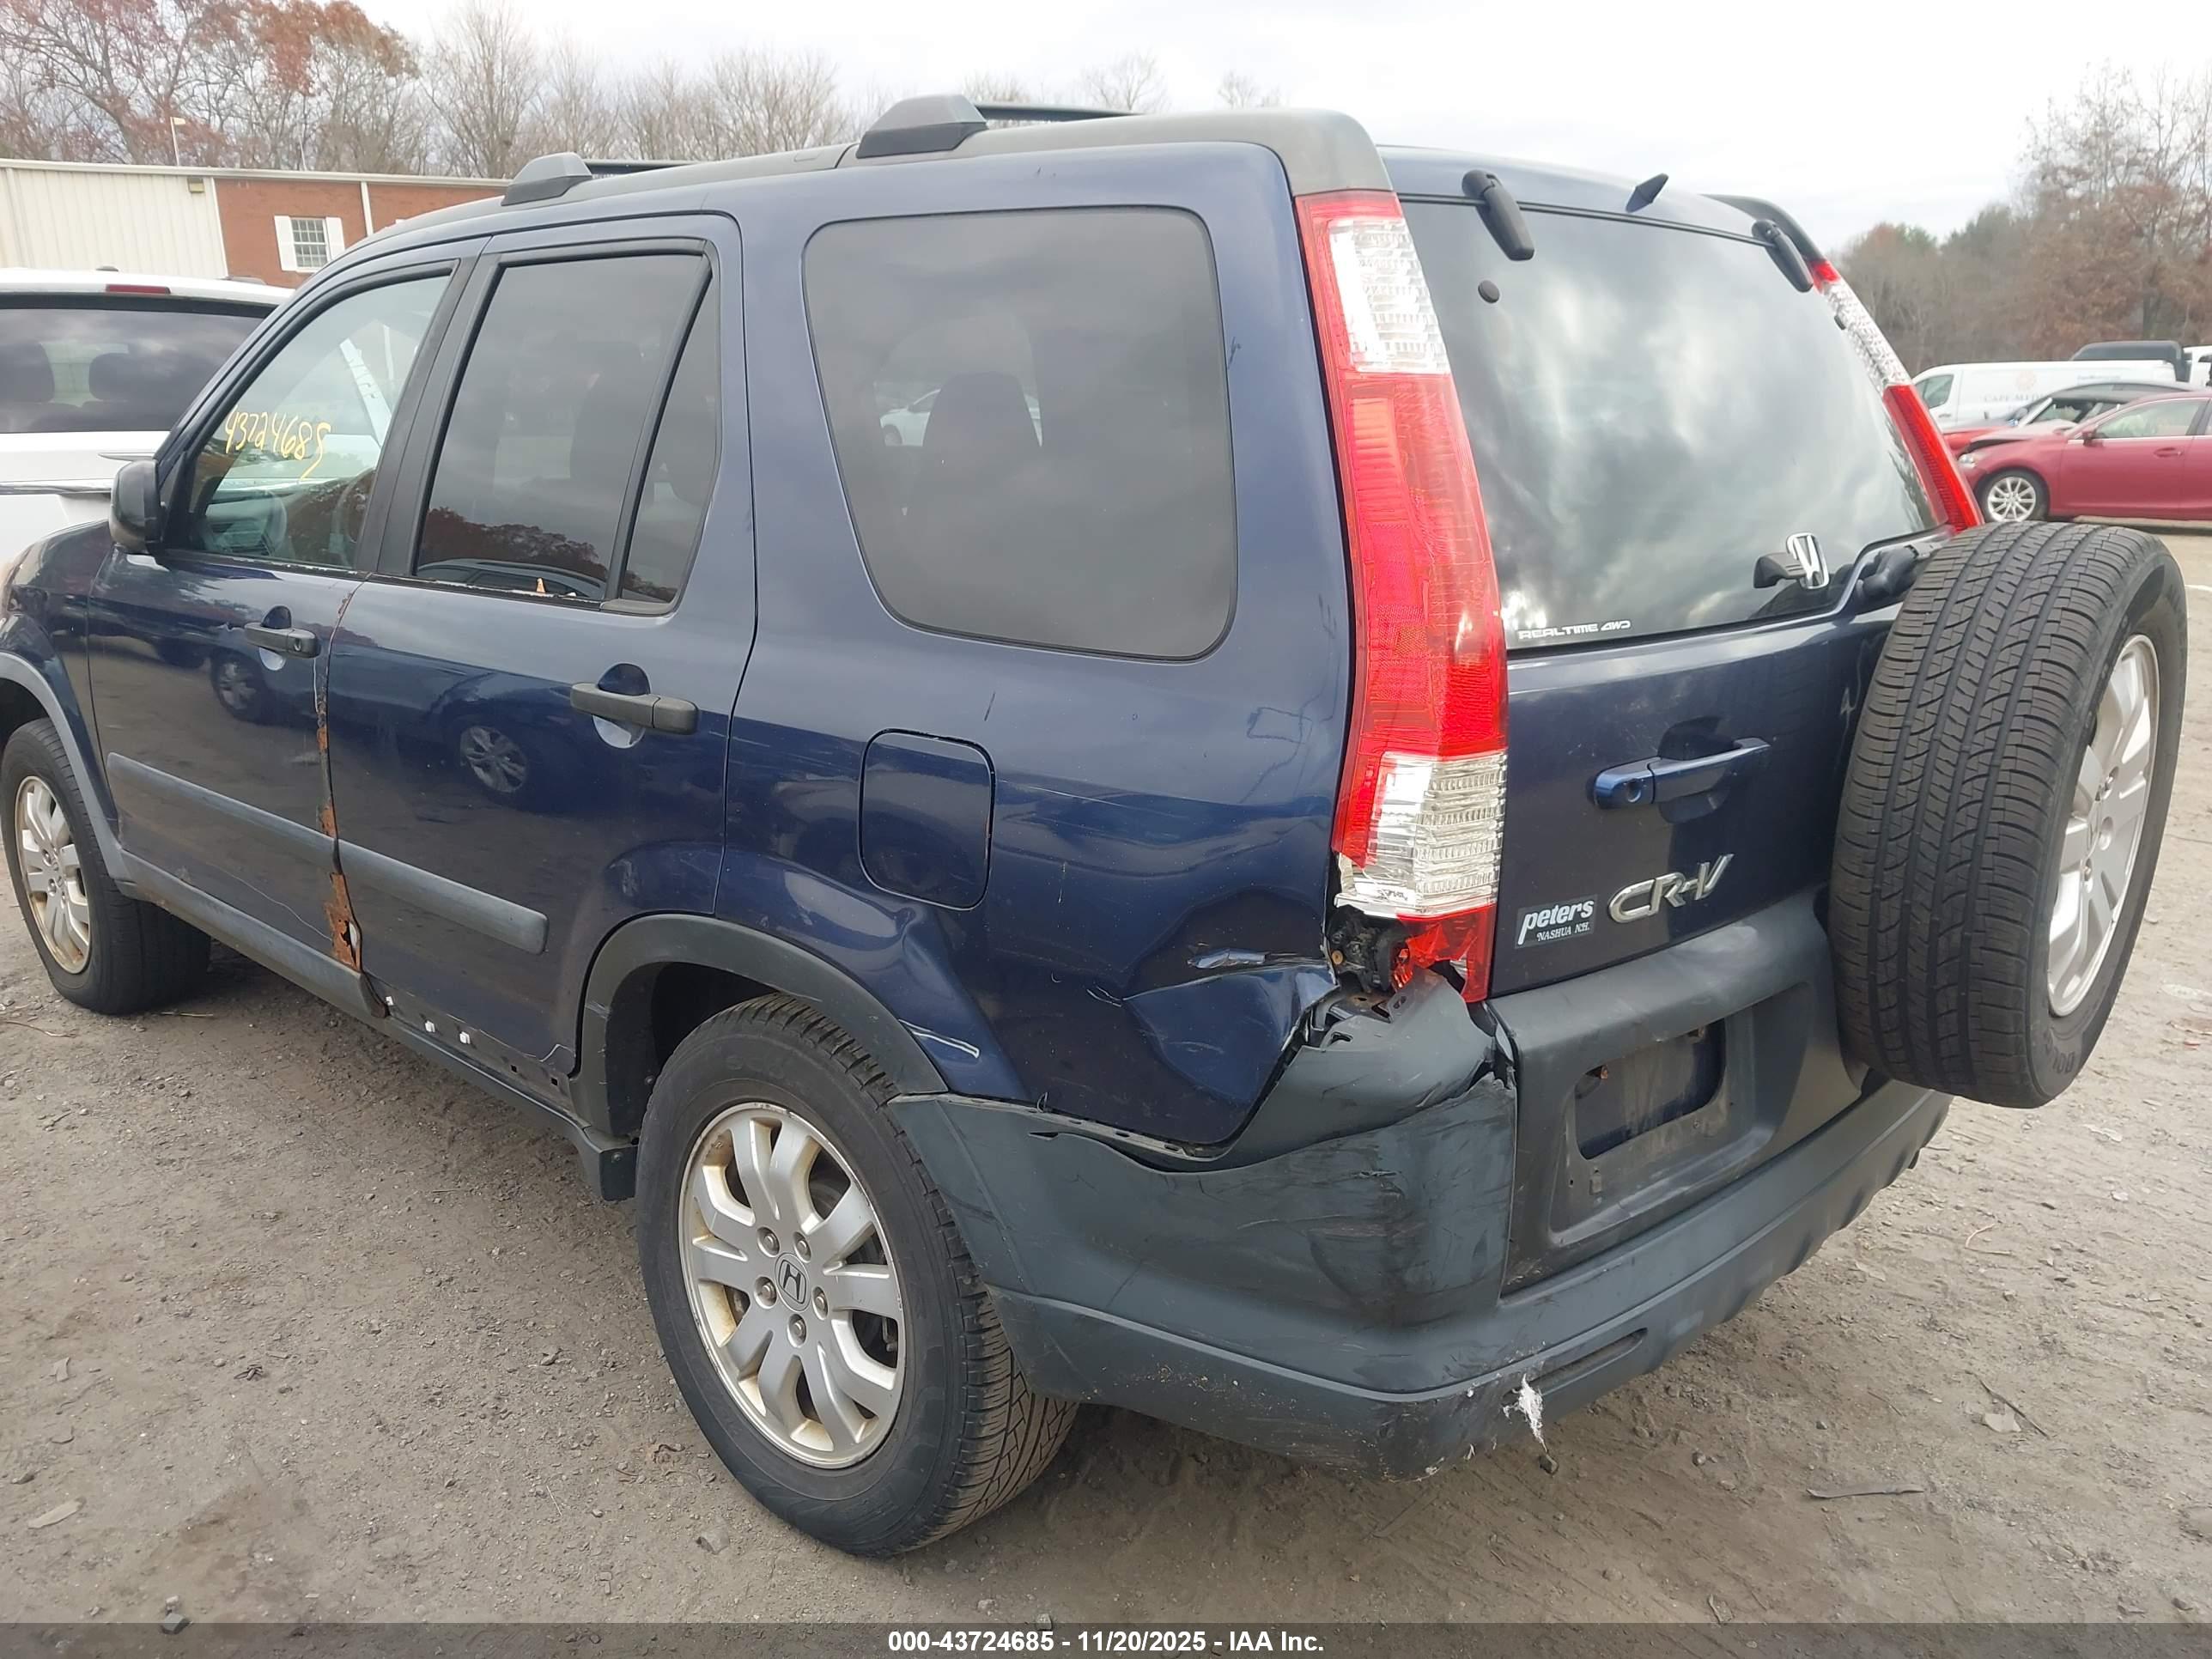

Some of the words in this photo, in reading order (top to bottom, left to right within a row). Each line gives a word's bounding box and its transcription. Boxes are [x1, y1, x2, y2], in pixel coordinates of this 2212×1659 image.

[1601, 620, 1632, 631] 4WD
[1608, 854, 1735, 924] CR-V
[1517, 900, 1595, 945] peters
[1536, 926, 1571, 942] NASHUA
